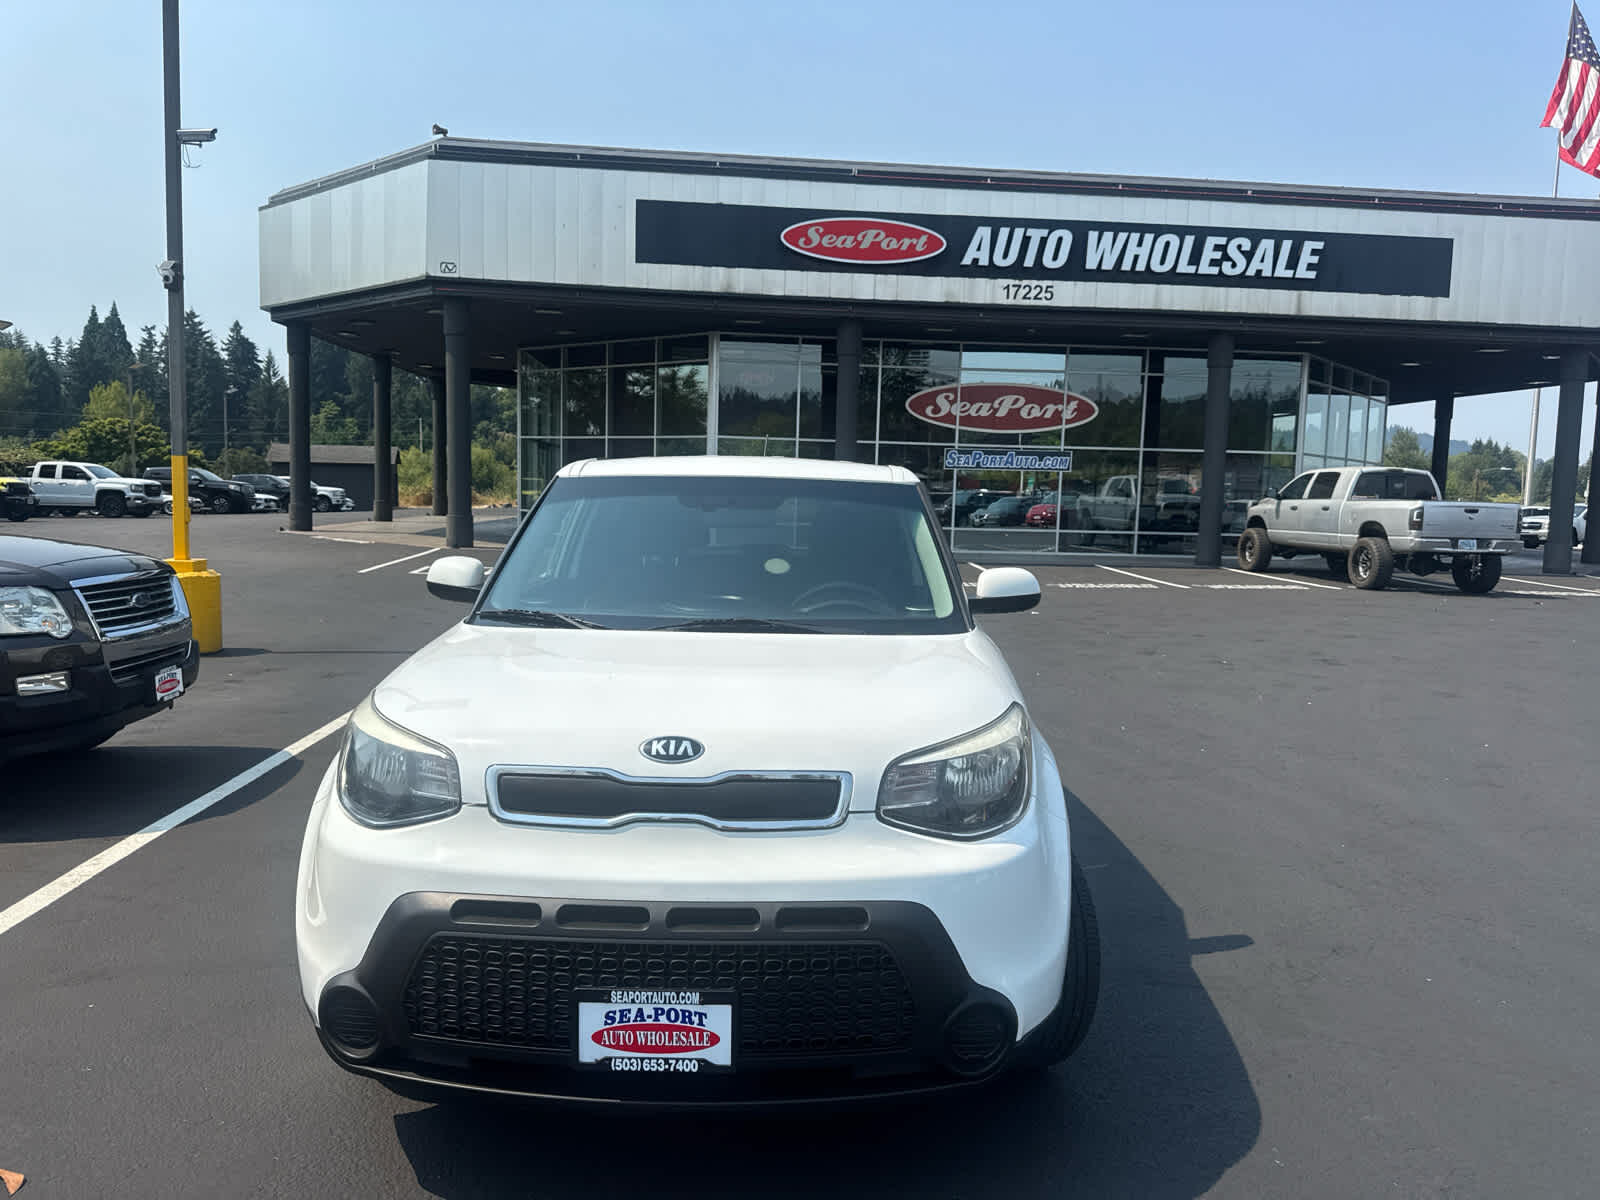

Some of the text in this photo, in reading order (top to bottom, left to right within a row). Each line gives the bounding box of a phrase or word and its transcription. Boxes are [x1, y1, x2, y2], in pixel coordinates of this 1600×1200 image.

[798, 226, 928, 252] SeaPort
[960, 226, 1325, 280] AUTO WHOLESALE
[1002, 283, 1055, 301] 17225
[651, 739, 694, 756] KIA
[610, 990, 700, 1005] SEAPORTAUTO.COM
[603, 1007, 708, 1027] SEA-PORT
[601, 1030, 711, 1047] AUTO WHOLESALE
